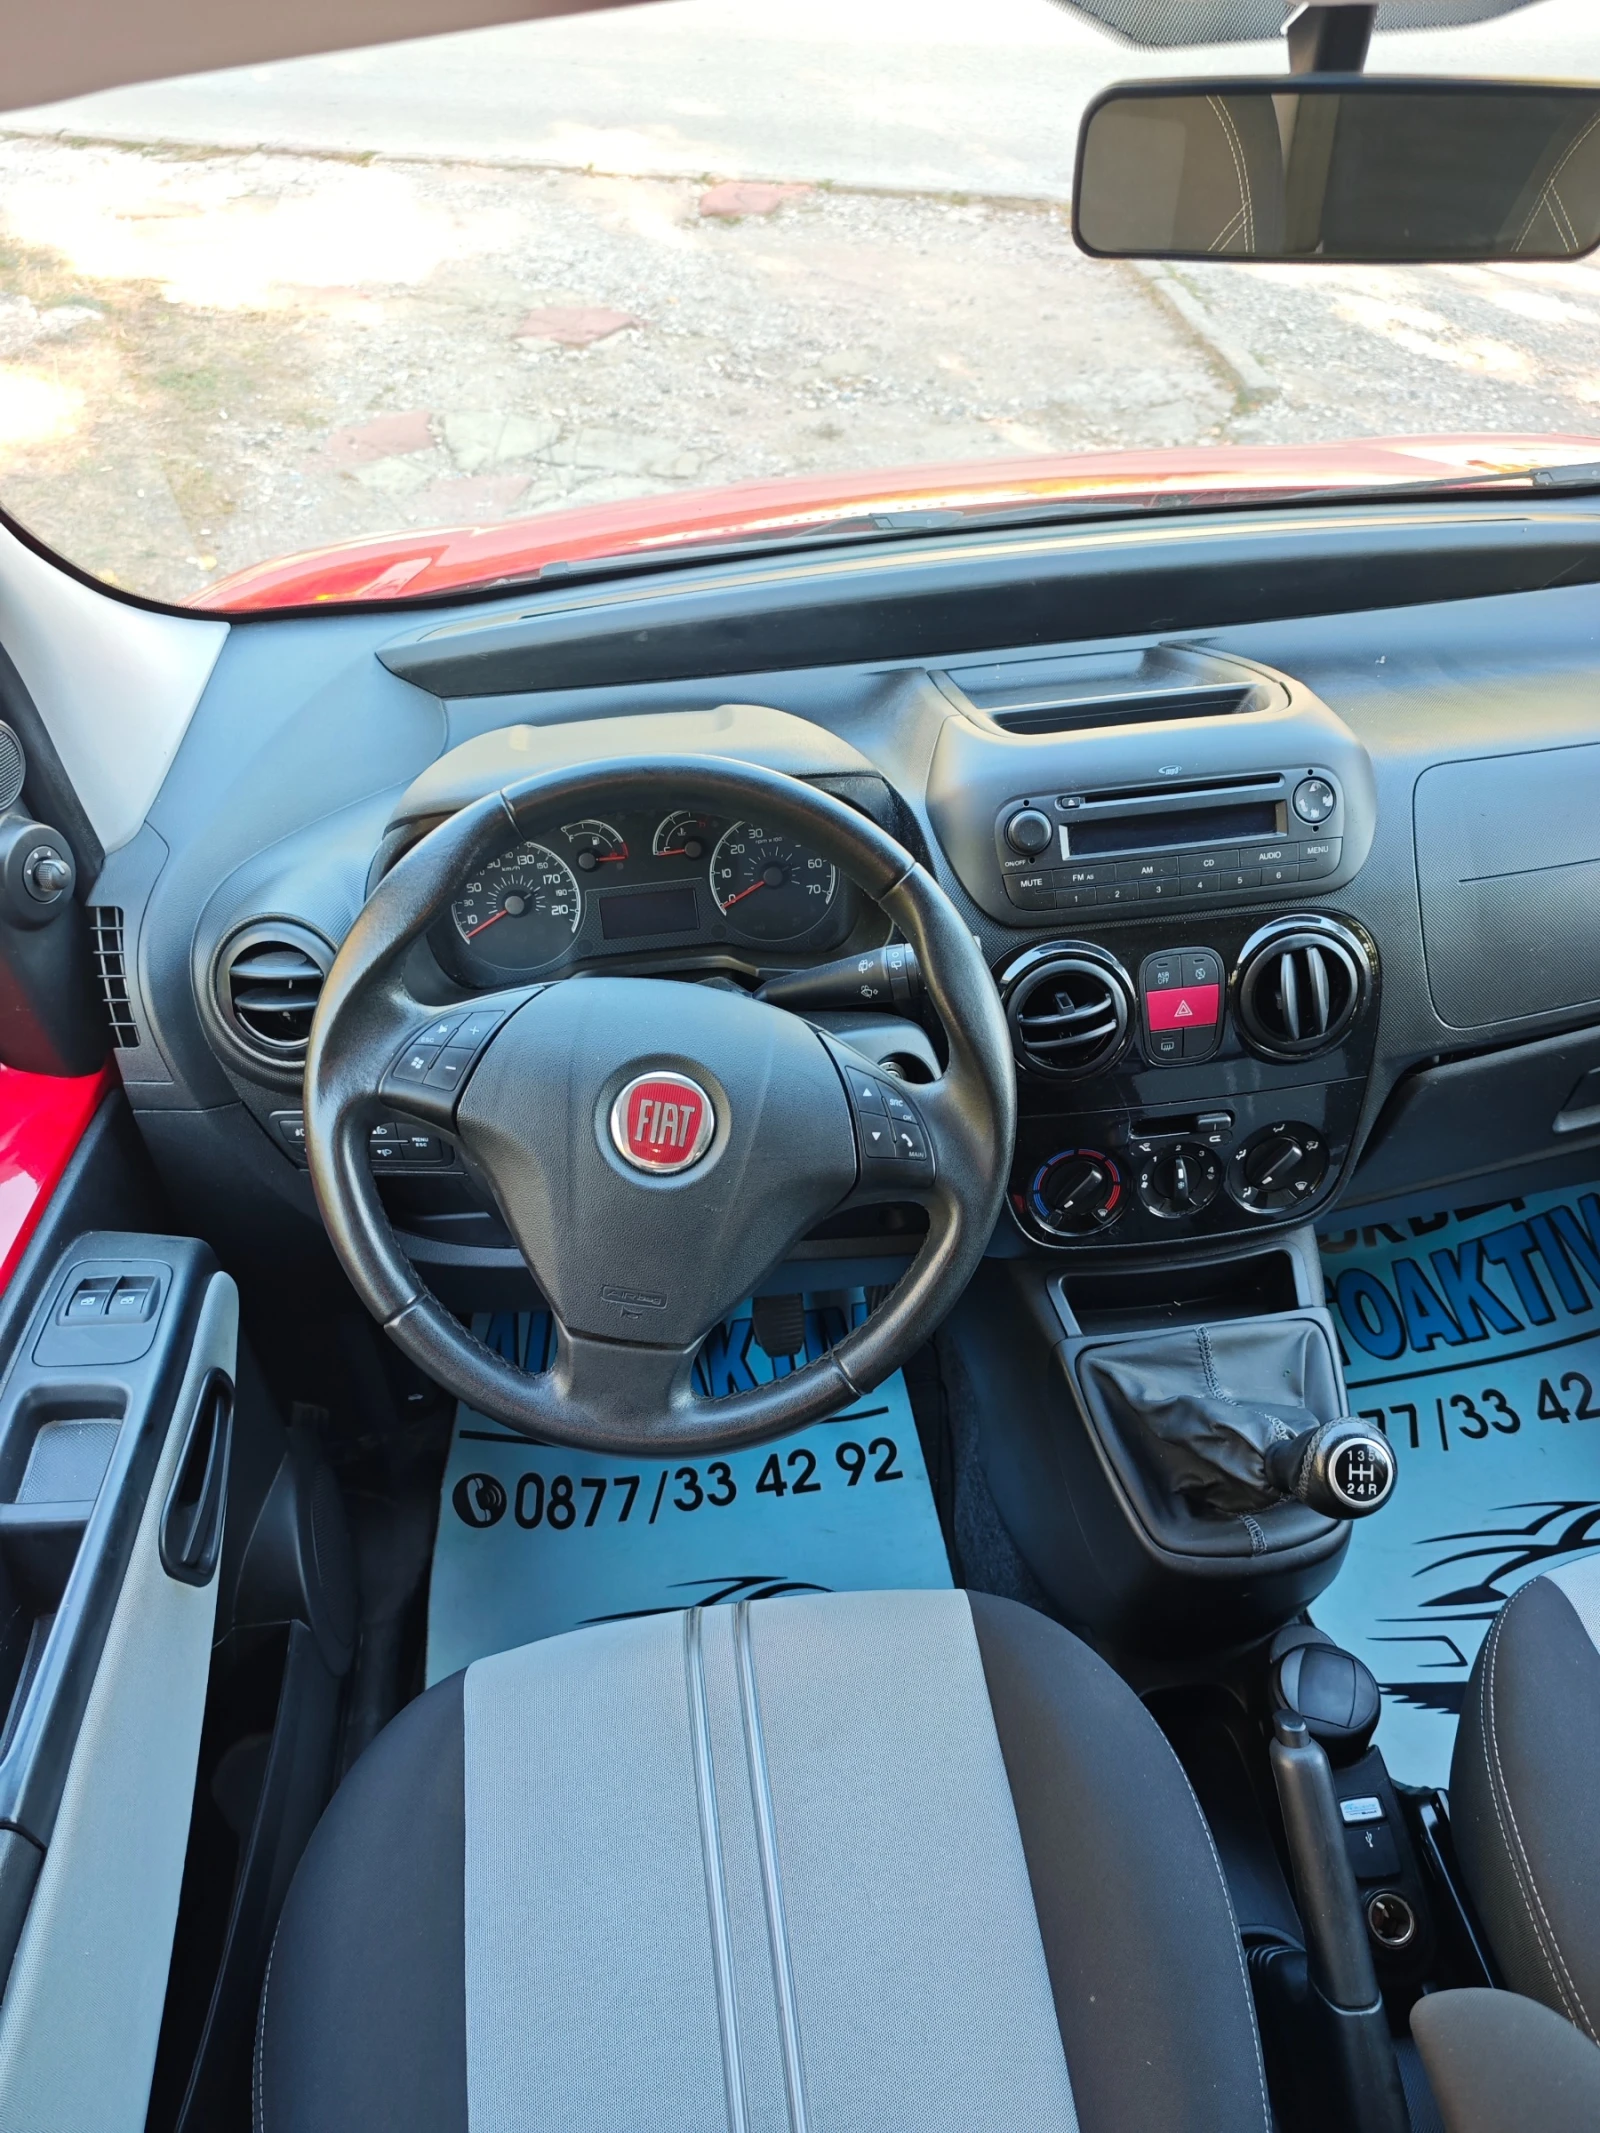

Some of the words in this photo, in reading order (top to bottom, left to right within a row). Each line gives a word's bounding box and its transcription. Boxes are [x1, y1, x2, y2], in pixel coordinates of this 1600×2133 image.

[748, 828, 763, 839] 30
[730, 844, 745, 855] 20
[1307, 845, 1329, 855] MENU
[516, 854, 535, 865] 130
[1258, 851, 1282, 861] AUDIO
[536, 862, 549, 870] 150
[807, 858, 822, 869] 60
[1004, 859, 1026, 868] ON/OFF
[1203, 859, 1215, 868] CD
[721, 868, 732, 879] 10
[1141, 866, 1154, 875] AM
[1276, 871, 1282, 880] 6
[542, 873, 561, 885] 170
[1072, 873, 1085, 882] FM
[1237, 876, 1243, 884] 5
[466, 882, 482, 893] 50
[1020, 878, 1043, 888] MUTE
[1197, 881, 1203, 889] 4
[555, 889, 568, 897] 190
[806, 884, 821, 895] 70
[1114, 890, 1121, 898] 2
[1156, 886, 1162, 894] 3
[463, 899, 474, 907] 30
[1073, 895, 1079, 903] 1
[551, 904, 569, 916] 210
[467, 914, 478, 925] 10
[1157, 971, 1170, 980] ASR
[889, 1098, 904, 1108] SRC
[634, 1098, 696, 1148] FIAT
[908, 1151, 925, 1159] MAIN
[1207, 1166, 1215, 1174] 4
[1326, 1192, 1600, 1366] OAKTIV
[1537, 1371, 1600, 1424] 42
[1357, 1450, 1365, 1462] 3
[1368, 1450, 1376, 1462] 5
[514, 1461, 738, 1530] 0877/33
[755, 1448, 822, 1498] 42
[835, 1437, 904, 1487] 92
[1347, 1484, 1355, 1495] 2
[1356, 1483, 1365, 1495] 4
[1368, 1483, 1377, 1495] R
